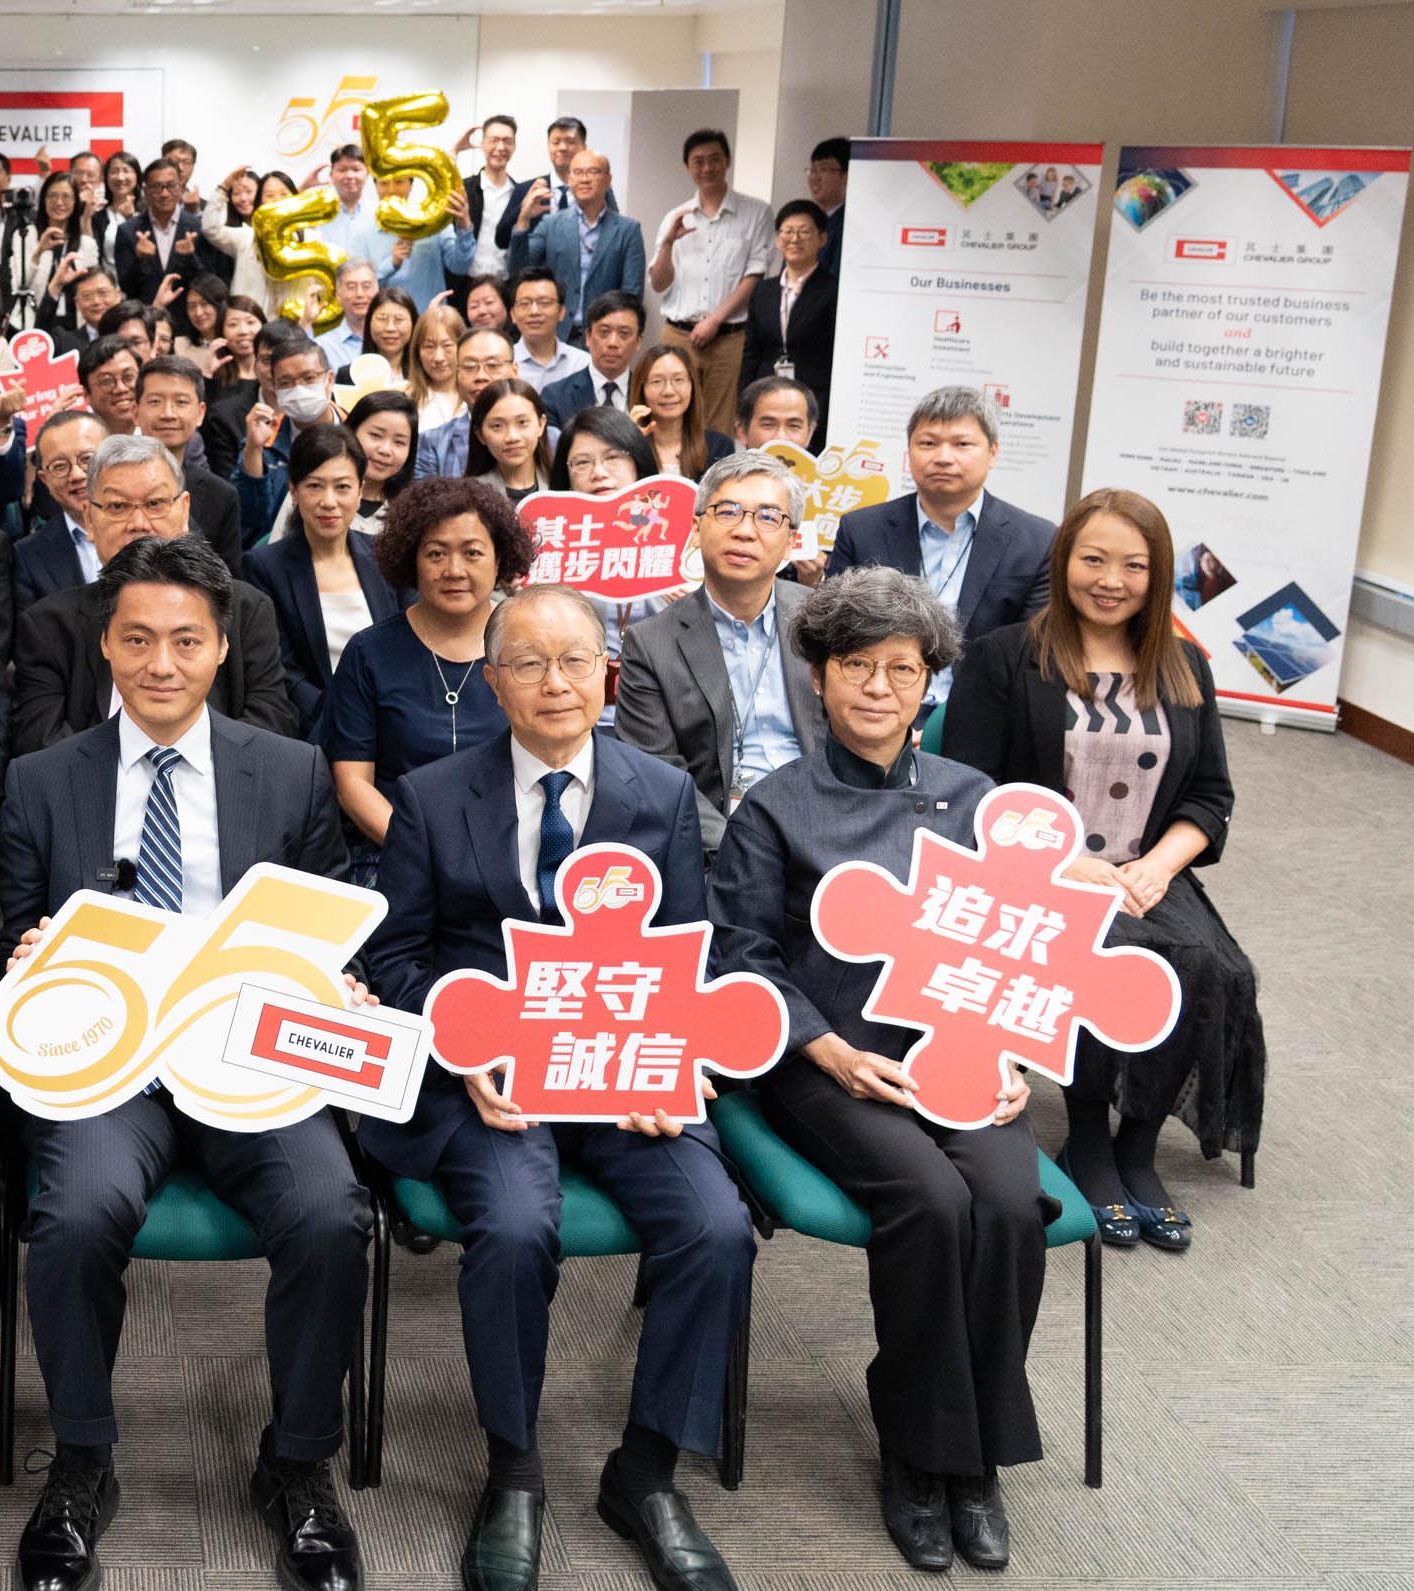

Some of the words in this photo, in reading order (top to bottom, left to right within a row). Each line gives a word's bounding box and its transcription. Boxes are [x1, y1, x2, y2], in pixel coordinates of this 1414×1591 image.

[960, 240, 1005, 250] CHEVALIER
[1007, 243, 1039, 251] GROUP
[1243, 254, 1295, 264] CHEVALIER
[1296, 257, 1332, 265] GROUP
[910, 276, 933, 289] Our
[936, 277, 1012, 293] Businesses
[1140, 289, 1158, 301] Be
[1162, 290, 1184, 302] the
[1187, 292, 1223, 305] most
[1227, 294, 1280, 308] trusted
[1284, 297, 1351, 312] business
[1152, 306, 1204, 320] partner
[1207, 309, 1222, 320] of
[1226, 312, 1249, 322] our
[1253, 312, 1332, 327] customers
[1224, 328, 1253, 339] and
[1150, 339, 1184, 353] build
[1187, 343, 1249, 358] together
[1253, 349, 1262, 357] a
[1265, 346, 1325, 363] brighter
[1155, 356, 1181, 368] and
[1184, 358, 1266, 374] sustainable
[1270, 363, 1315, 377] future
[803, 479, 863, 512] 大步
[1167, 485, 1269, 501] www.chevalier.com
[532, 514, 605, 549] 其士
[526, 544, 677, 585] 邁步閃耀
[912, 874, 1068, 966] 追求
[519, 961, 664, 1022] 堅守
[921, 957, 1075, 1044] 卓越
[35, 1036, 81, 1059] Since
[80, 1015, 115, 1049] 1970
[287, 1031, 355, 1061] CHEVALIER
[543, 1031, 688, 1092] 誠信
